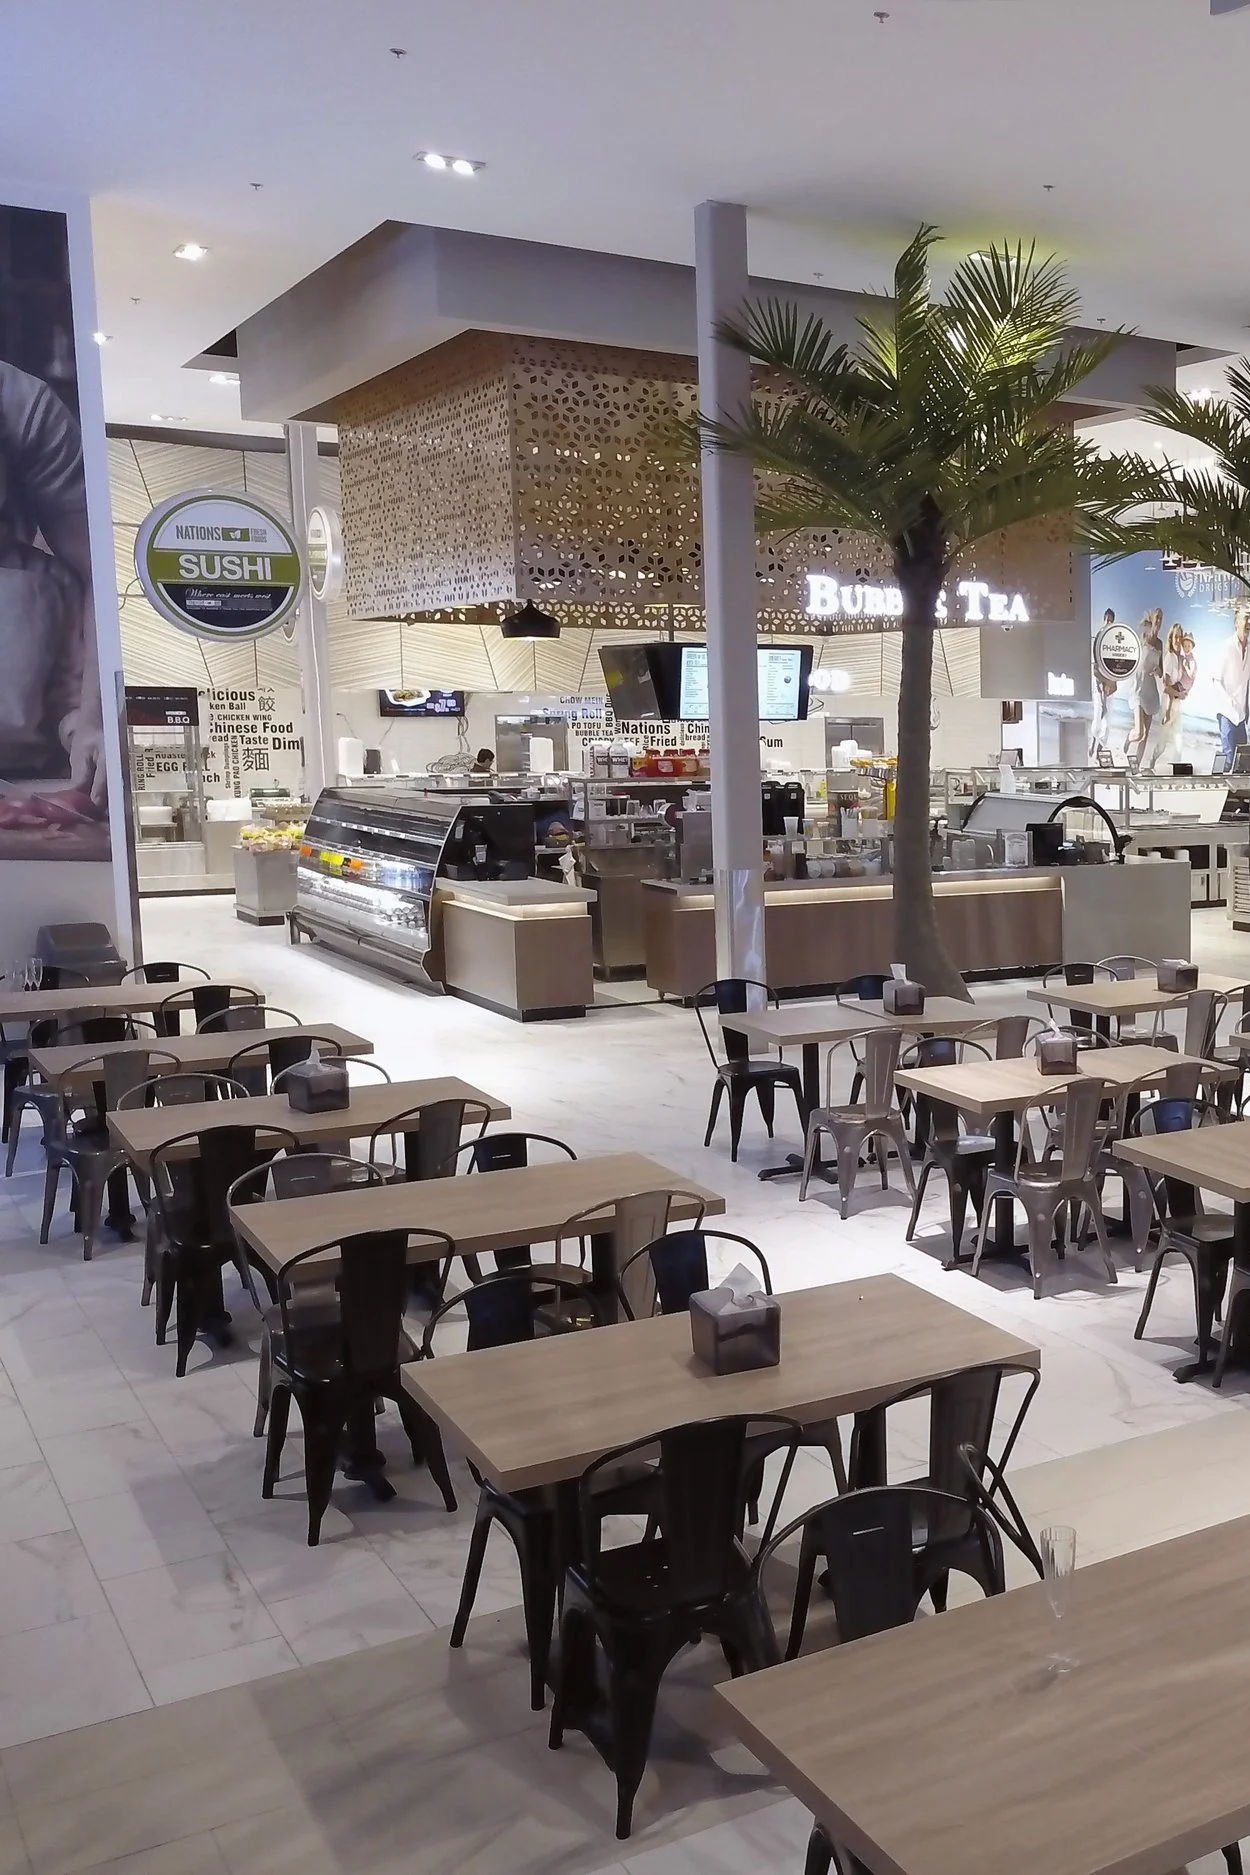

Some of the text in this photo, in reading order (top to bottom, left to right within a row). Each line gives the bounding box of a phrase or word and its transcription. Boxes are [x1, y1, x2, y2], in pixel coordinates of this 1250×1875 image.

[175, 525, 221, 541] NATIONS
[178, 554, 272, 581] SUSHI
[805, 574, 1030, 622] BUBBE TEA
[1102, 644, 1137, 653] PHARMACY
[228, 702, 247, 710] Ball
[559, 696, 583, 704] CHOW
[217, 713, 251, 721] CHICKEN
[252, 713, 273, 721] WING
[581, 708, 603, 719] Roll
[605, 711, 614, 728] BBQ
[262, 721, 294, 734] Food
[621, 721, 671, 735] Nations
[687, 723, 710, 734] Chin
[239, 734, 269, 745] Taste
[272, 736, 300, 751] Dim
[642, 734, 650, 751] Rice
[650, 735, 677, 747] Fried
[685, 733, 706, 741] bread
[230, 734, 240, 764] CHICKEN
[242, 746, 270, 771] 麵
[156, 761, 179, 772] EGG
[232, 765, 241, 780] PAO
